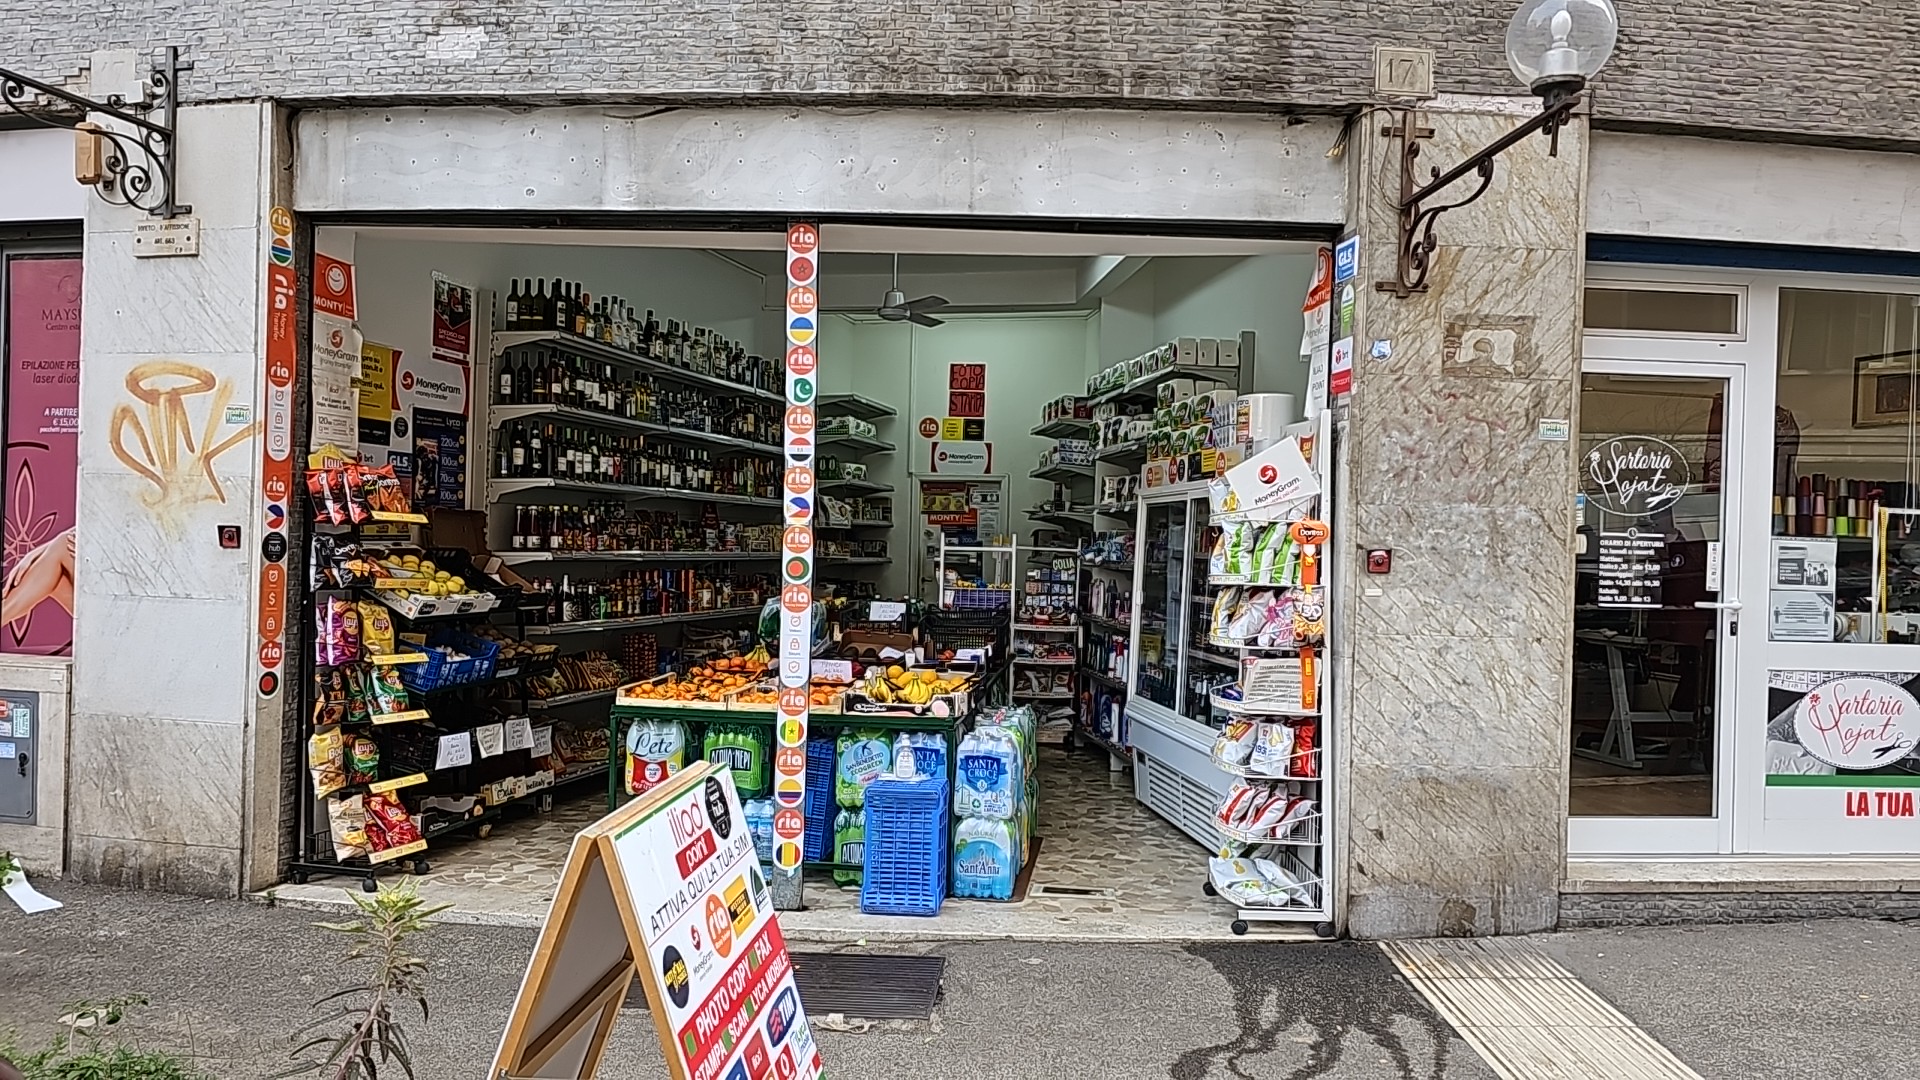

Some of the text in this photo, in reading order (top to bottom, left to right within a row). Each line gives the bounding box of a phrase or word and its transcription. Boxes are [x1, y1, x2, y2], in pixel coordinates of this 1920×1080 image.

[272, 209, 291, 226] ria
[791, 227, 814, 244] ria
[1339, 247, 1353, 267] GLS
[274, 273, 294, 309] ria
[790, 288, 814, 304] ria
[314, 296, 344, 313] MONTY
[314, 343, 359, 363] MoneyGram
[790, 348, 813, 365] ria
[21, 361, 65, 370] EPILAZIONE
[270, 361, 289, 377] ria
[953, 366, 982, 378] FOTO
[33, 373, 55, 384] laser
[416, 377, 461, 394] MoneyGram
[952, 376, 984, 390] COPIA
[1312, 380, 1325, 392] POINT
[44, 407, 77, 416] A PARTIRE
[789, 408, 812, 424] ria
[921, 420, 936, 431] ria
[364, 454, 374, 463] brt
[390, 455, 409, 467] GLS
[1602, 442, 1673, 474] Sartoria
[266, 476, 285, 492] ria
[787, 467, 811, 484] ria
[1254, 477, 1300, 505] MoneyGram
[787, 527, 810, 544] ria
[268, 544, 281, 552] hub
[785, 587, 808, 603] ria
[261, 643, 280, 658] ria
[782, 690, 805, 706] ria
[1824, 683, 1904, 720] Sartoria
[356, 743, 374, 753] Lay's
[630, 731, 674, 757] Lete
[734, 750, 751, 769] NEPI
[779, 749, 802, 766] ria
[917, 749, 938, 762] NTA
[851, 759, 884, 776] ECOGREEN
[917, 760, 936, 769] OCE
[967, 759, 998, 771] SANTA
[967, 768, 998, 780] CROCE
[1846, 792, 1914, 816] LA TUA
[667, 793, 703, 848] iliad
[777, 812, 801, 829] ria
[685, 835, 709, 872] point
[958, 860, 1001, 875] Sant'Anna
[650, 832, 749, 937] ATTIVA QUI LA TUA SIM
[709, 901, 728, 940] ria
[693, 950, 714, 975] MoneyGram
[695, 987, 730, 1045] PHOTO
[727, 955, 752, 1001] COPY
[754, 930, 773, 965] FAX
[694, 949, 789, 1080] STAMPA SCAN LYCA MOBILE
[779, 991, 795, 1026] TIM
